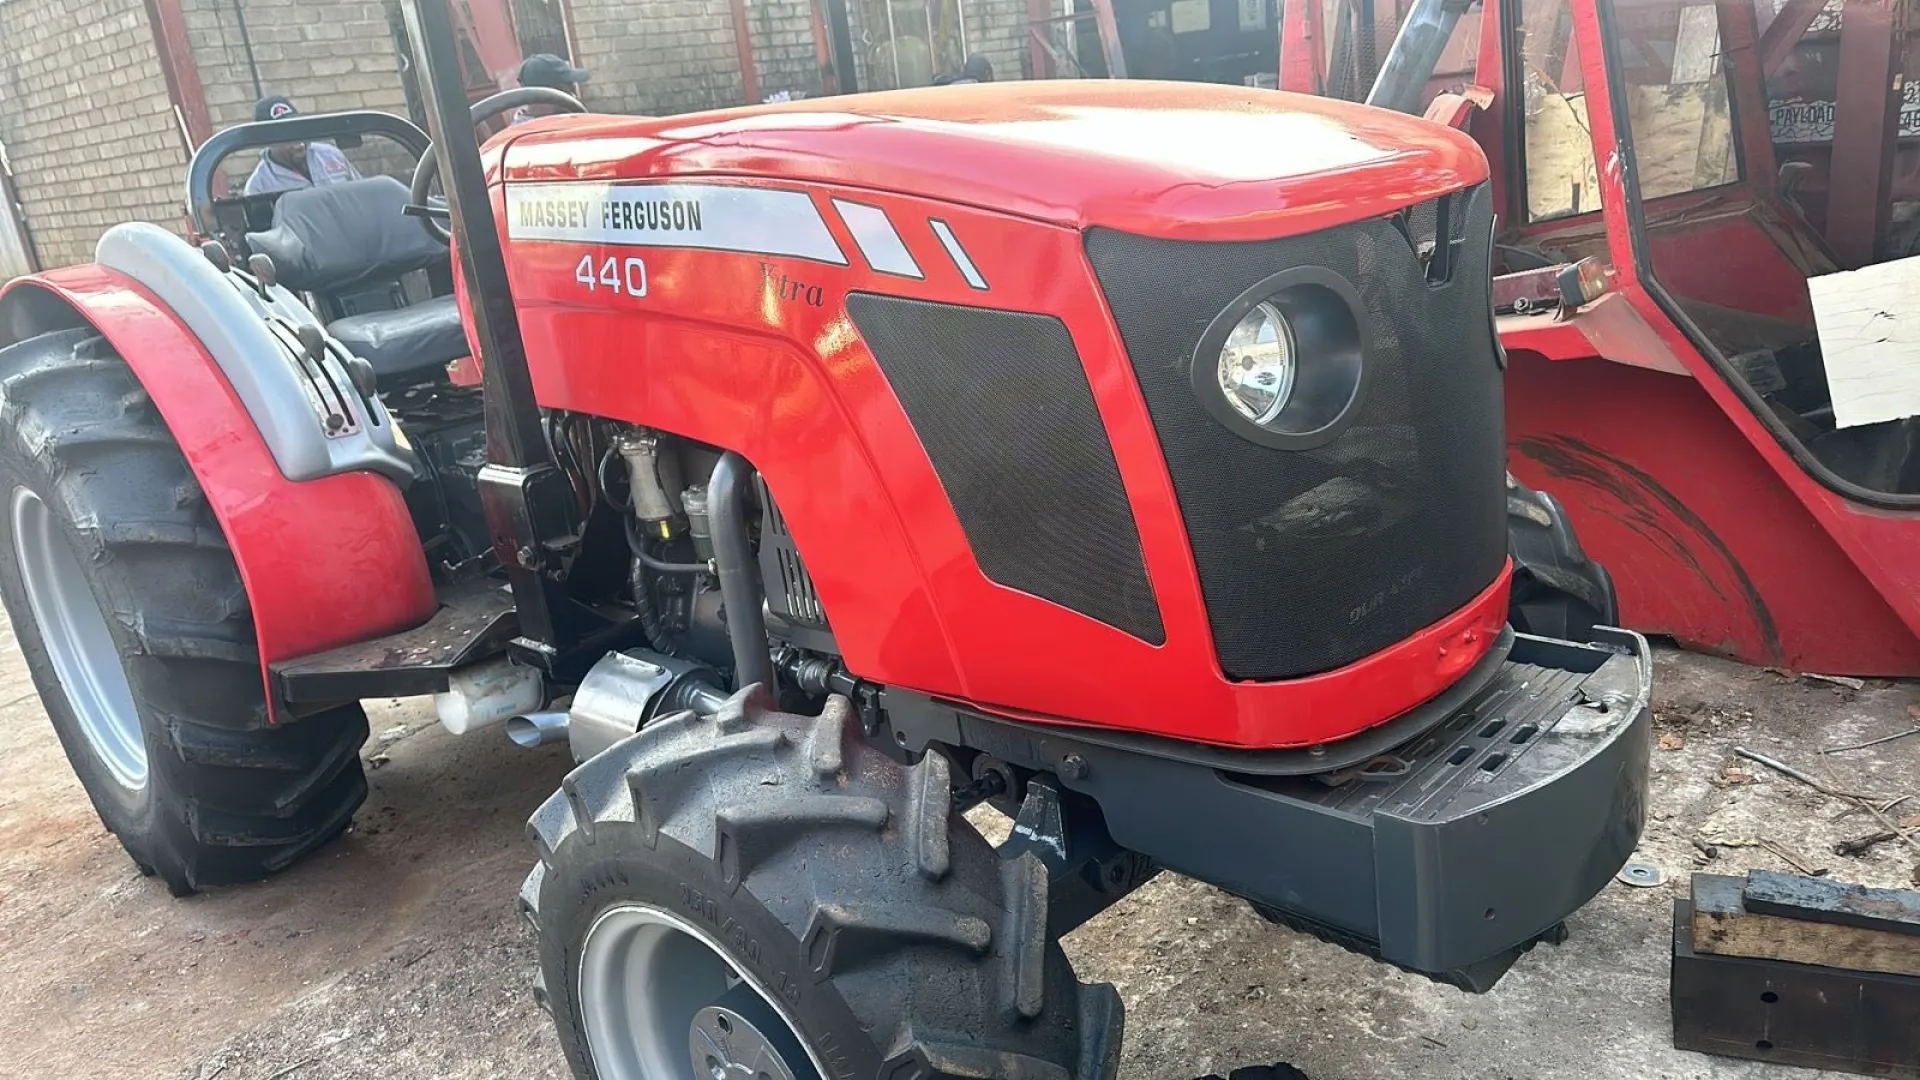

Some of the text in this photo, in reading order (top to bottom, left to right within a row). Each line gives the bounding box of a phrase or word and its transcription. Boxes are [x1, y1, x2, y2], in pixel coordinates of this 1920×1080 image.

[1775, 105, 1835, 127] PAYLOAD
[519, 201, 703, 231] MASSEY FERGUSON
[575, 253, 648, 298] 440
